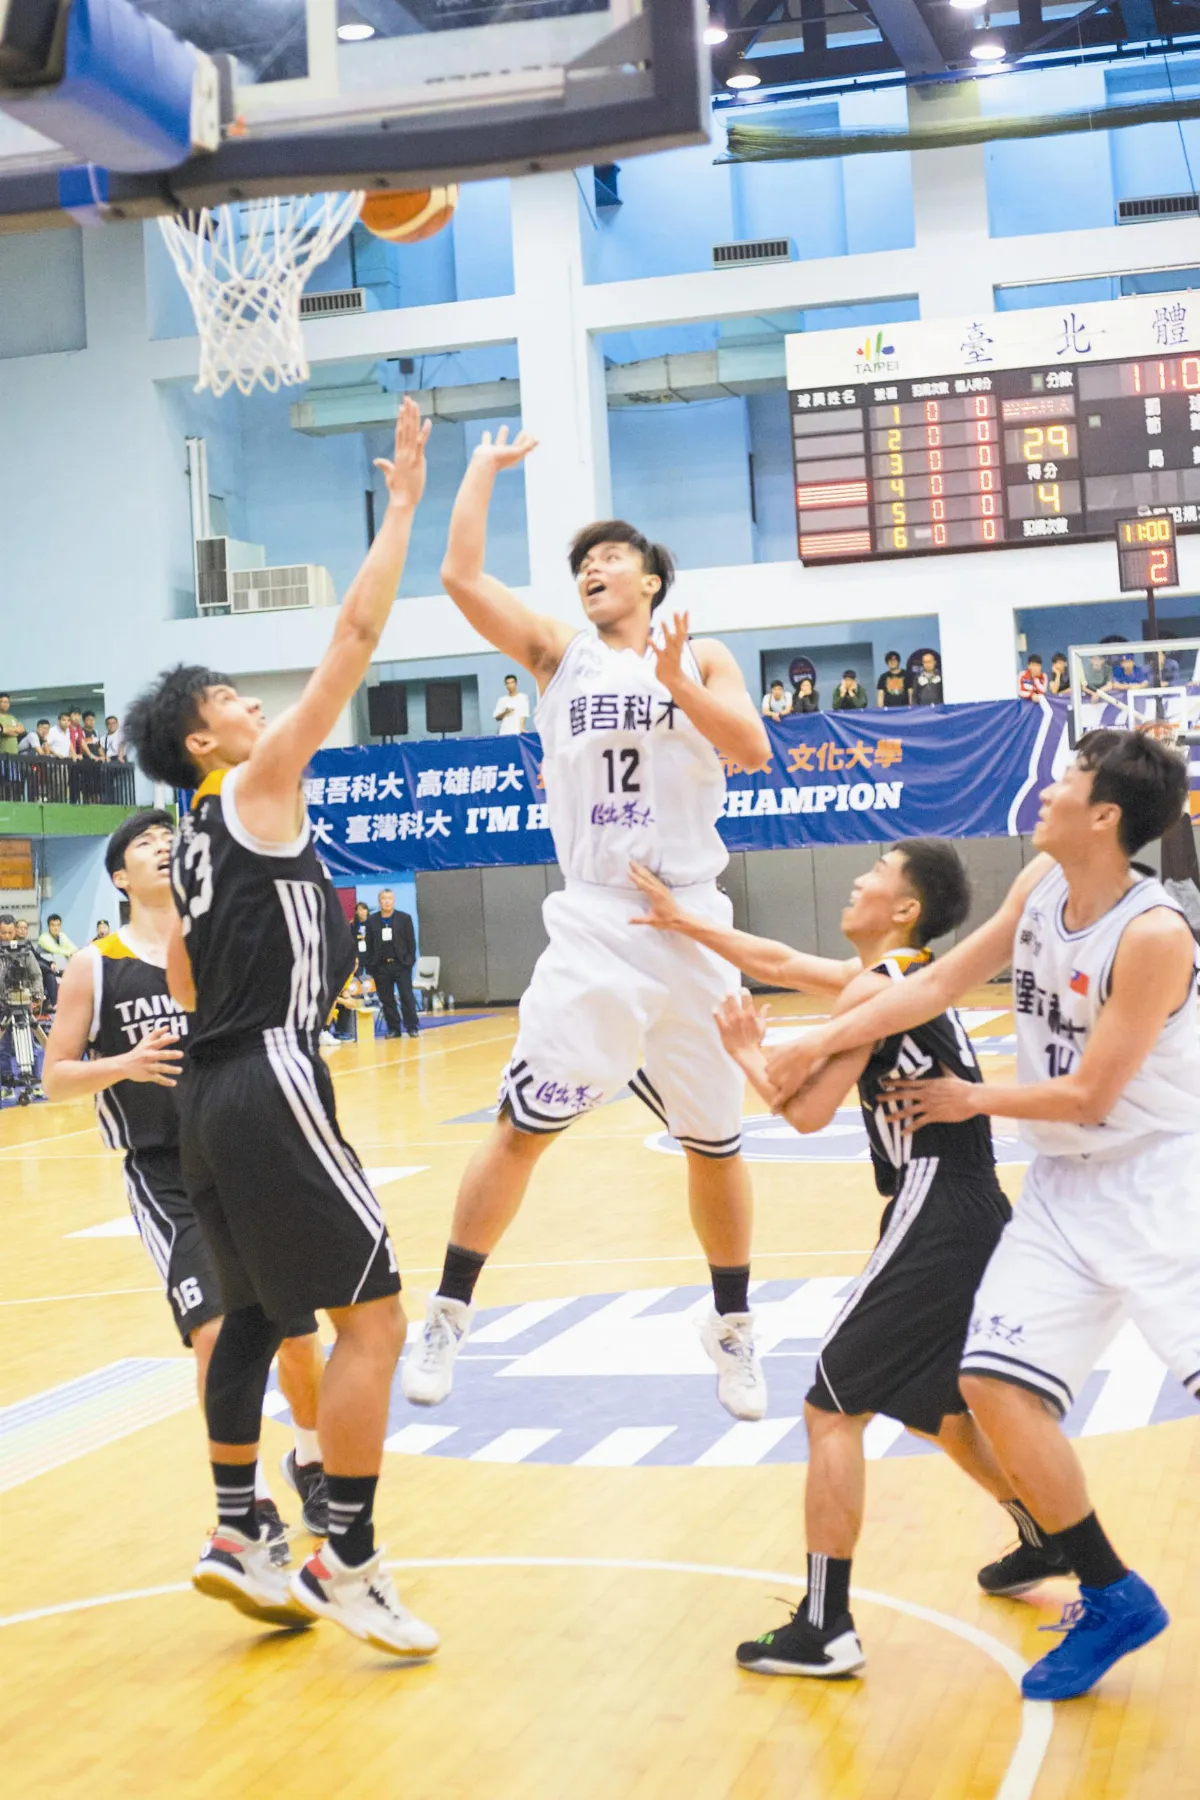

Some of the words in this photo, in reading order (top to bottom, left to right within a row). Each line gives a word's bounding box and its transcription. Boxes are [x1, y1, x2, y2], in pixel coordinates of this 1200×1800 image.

[854, 360, 899, 374] TAIPEI
[893, 406, 900, 424] 1
[926, 401, 939, 421] 0
[975, 396, 988, 417] 0
[888, 429, 901, 450] 2
[928, 425, 940, 446] 0
[977, 421, 990, 441] 0
[1022, 425, 1070, 461] 29
[889, 453, 903, 475] 3
[929, 450, 941, 470] 0
[979, 445, 991, 466] 0
[890, 479, 905, 498] 4
[931, 475, 943, 495] 0
[980, 470, 992, 490] 0
[1038, 483, 1061, 513] 4
[892, 502, 905, 524] 5
[932, 499, 945, 519] 0
[981, 494, 994, 515] 0
[894, 526, 908, 549] 6
[933, 523, 946, 544] 0
[983, 519, 995, 540] 0
[1124, 520, 1171, 544] 11:00
[1150, 549, 1169, 583] 2
[602, 748, 641, 793] 12
[786, 738, 903, 774] 文化大學
[303, 771, 404, 806] 醒吾科大
[416, 762, 525, 799] 高雄師大
[345, 809, 453, 845] 臺灣科大
[465, 804, 521, 835] I'M
[172, 1276, 204, 1317] 16
